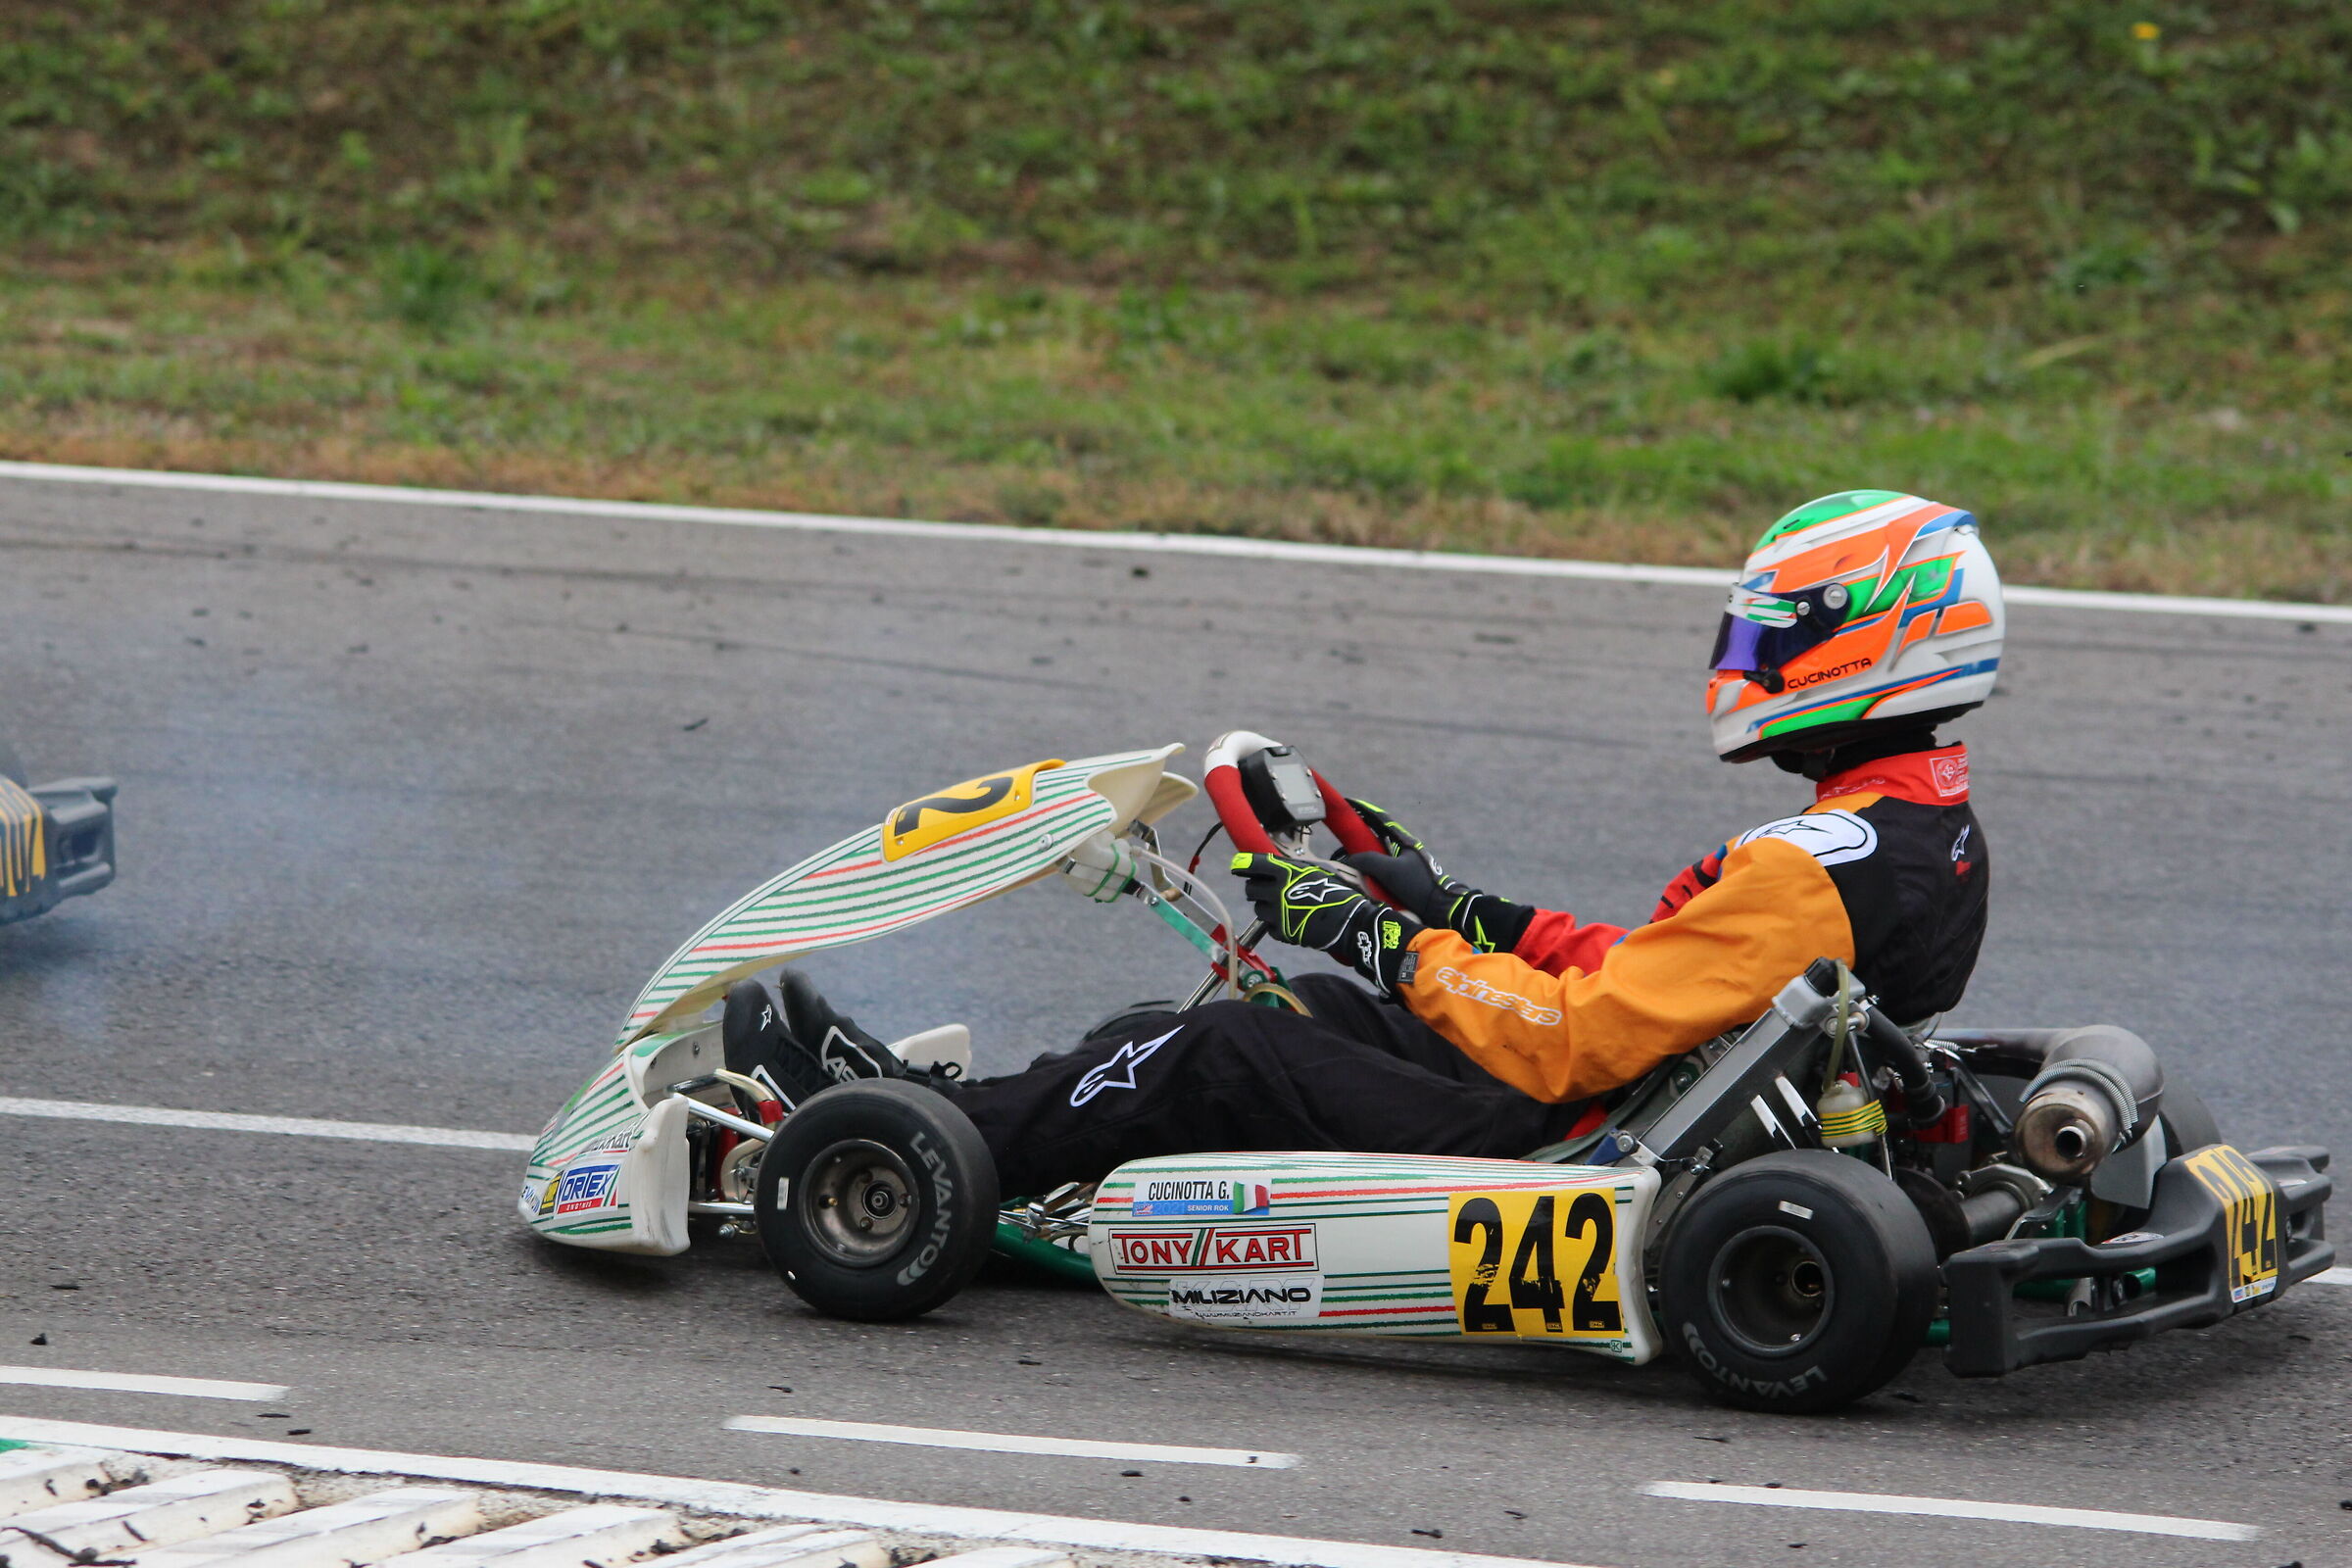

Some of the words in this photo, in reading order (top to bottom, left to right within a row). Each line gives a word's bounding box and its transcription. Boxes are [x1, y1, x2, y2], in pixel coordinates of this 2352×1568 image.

[1787, 658, 1873, 689] CUCINOTTA
[556, 1164, 620, 1203] VORTEX
[909, 1131, 954, 1268] LEVANTO
[1148, 1181, 1213, 1200] CUCINOTTA
[1218, 1181, 1230, 1200] G.
[1111, 1233, 1193, 1264] TONY
[1215, 1228, 1311, 1263] KART
[1454, 1192, 1623, 1333] 242
[1171, 1287, 1311, 1304] MILIZIANO
[1697, 1348, 1828, 1399] LEVANTO
